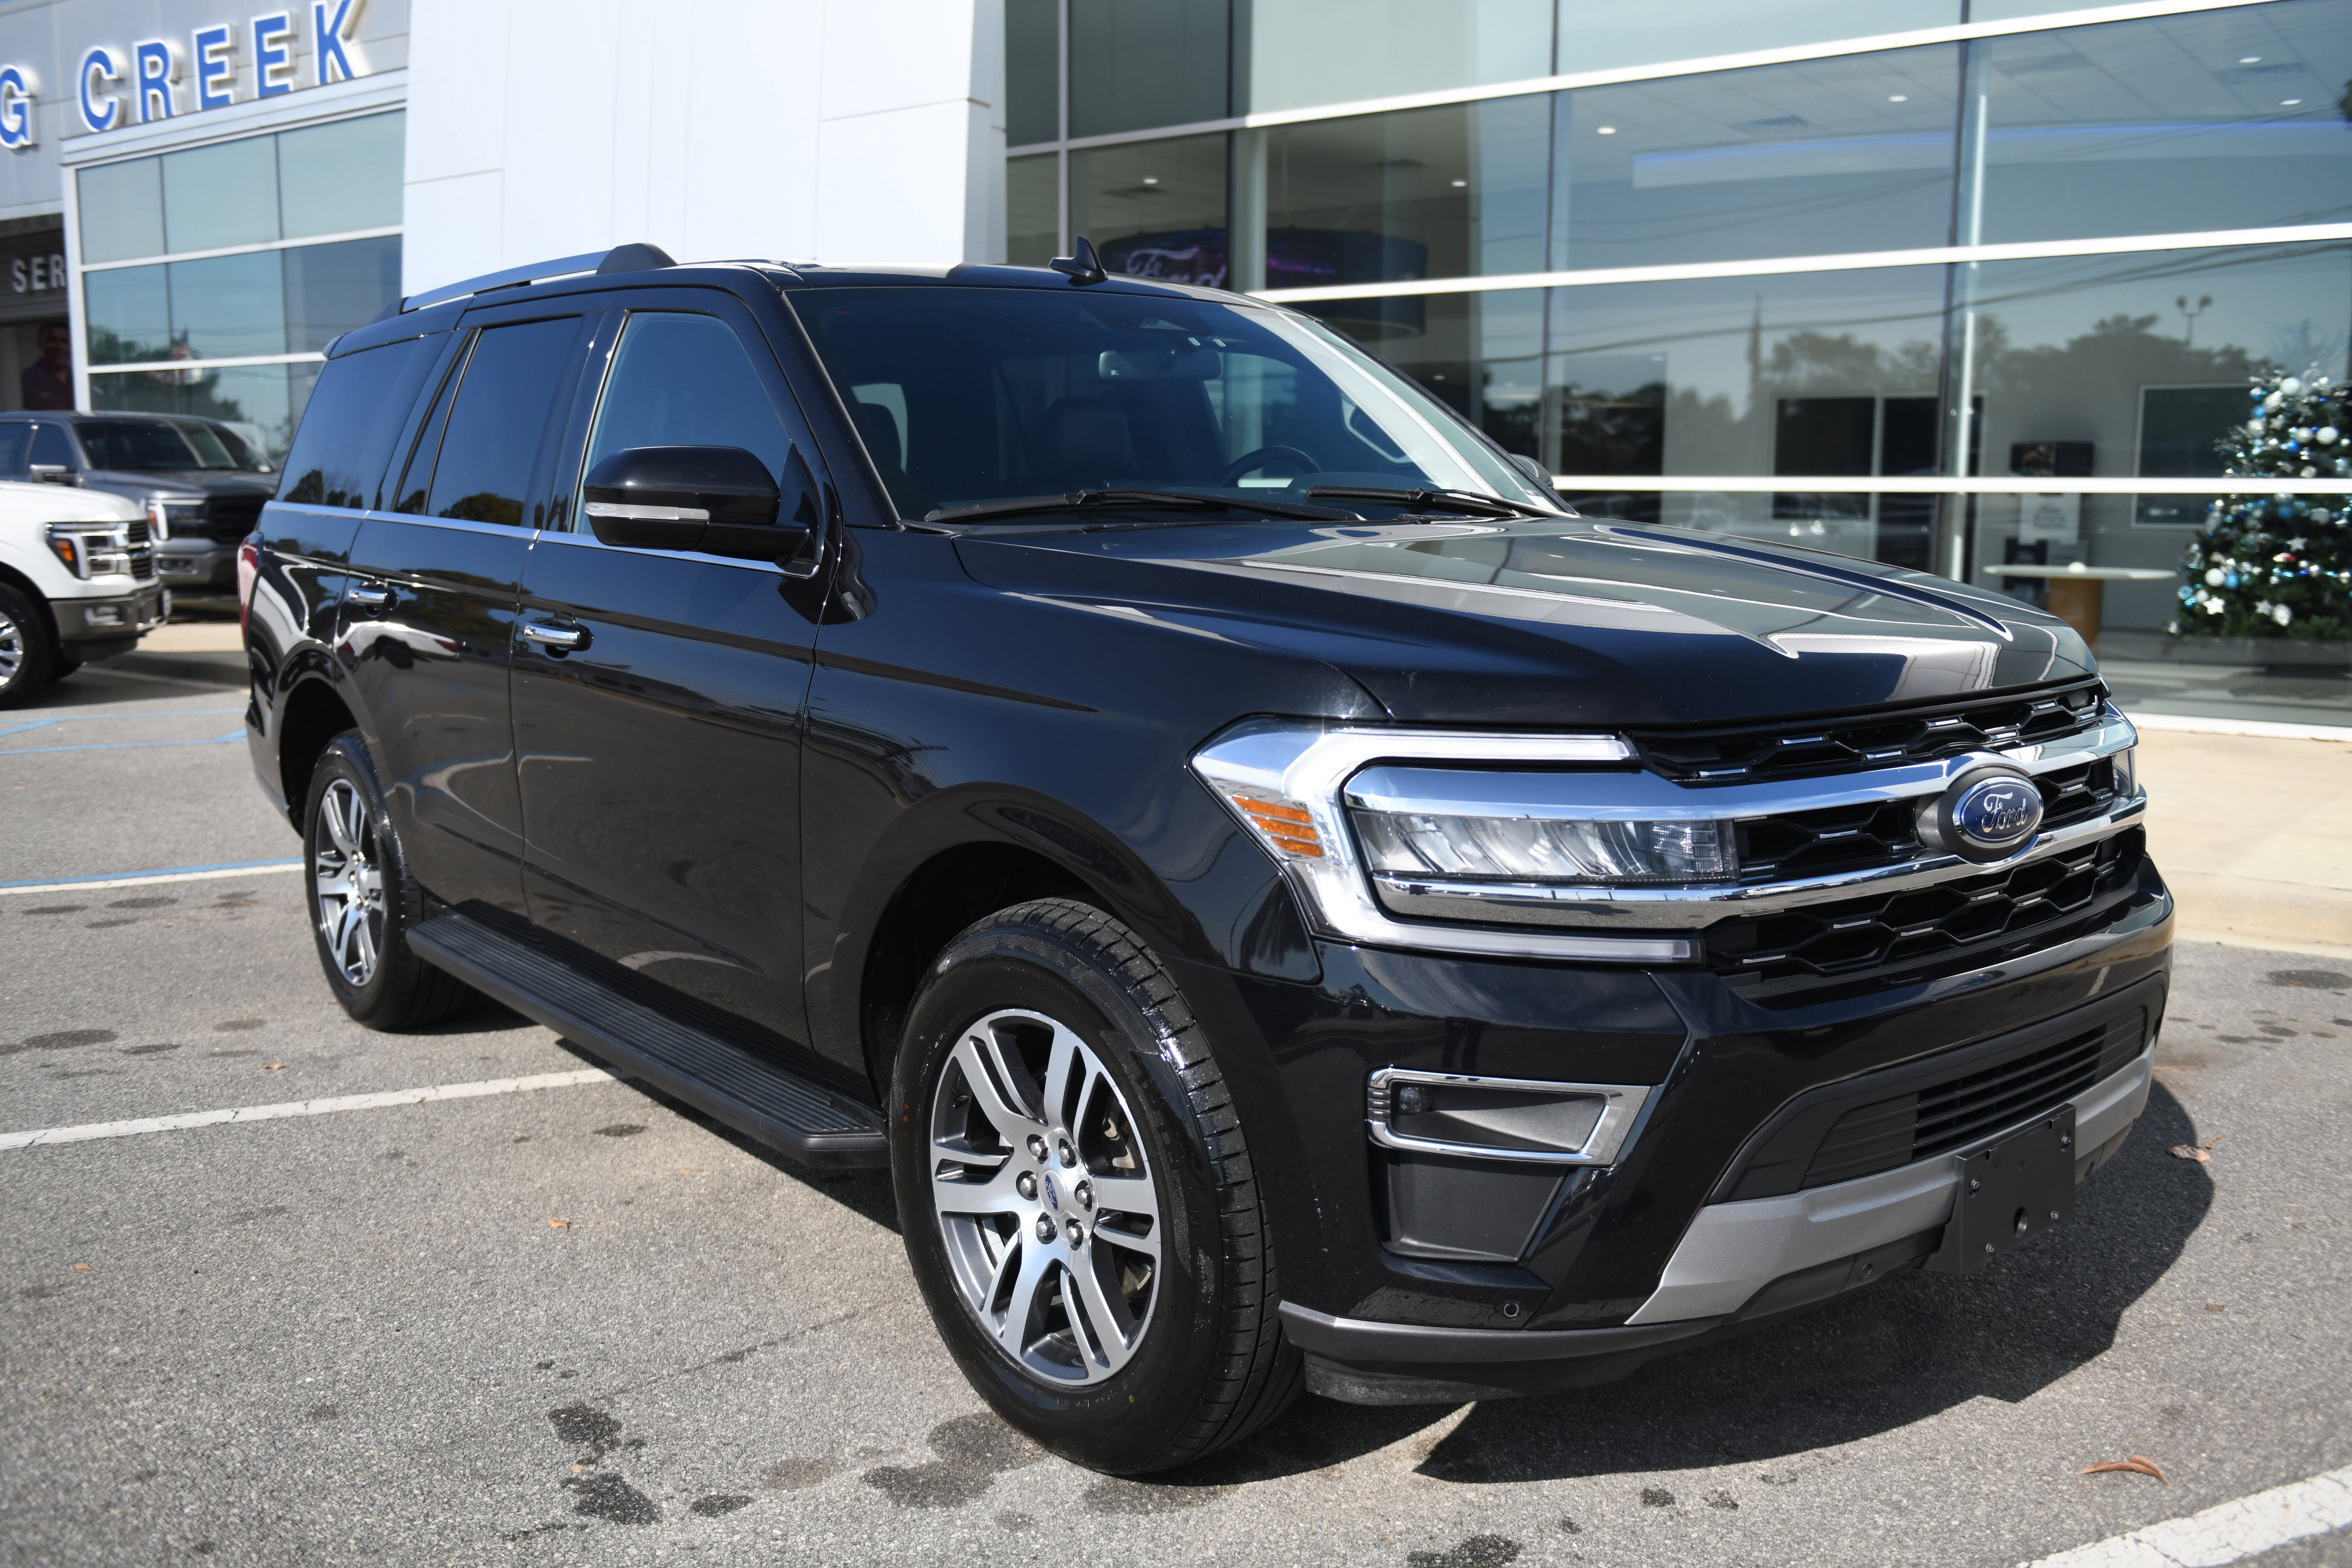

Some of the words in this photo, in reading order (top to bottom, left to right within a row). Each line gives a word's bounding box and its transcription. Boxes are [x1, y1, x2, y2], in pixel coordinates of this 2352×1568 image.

[79, 0, 360, 132] CREEK
[1981, 791, 2028, 833] Ford
[1046, 1181, 1056, 1203] Ford
